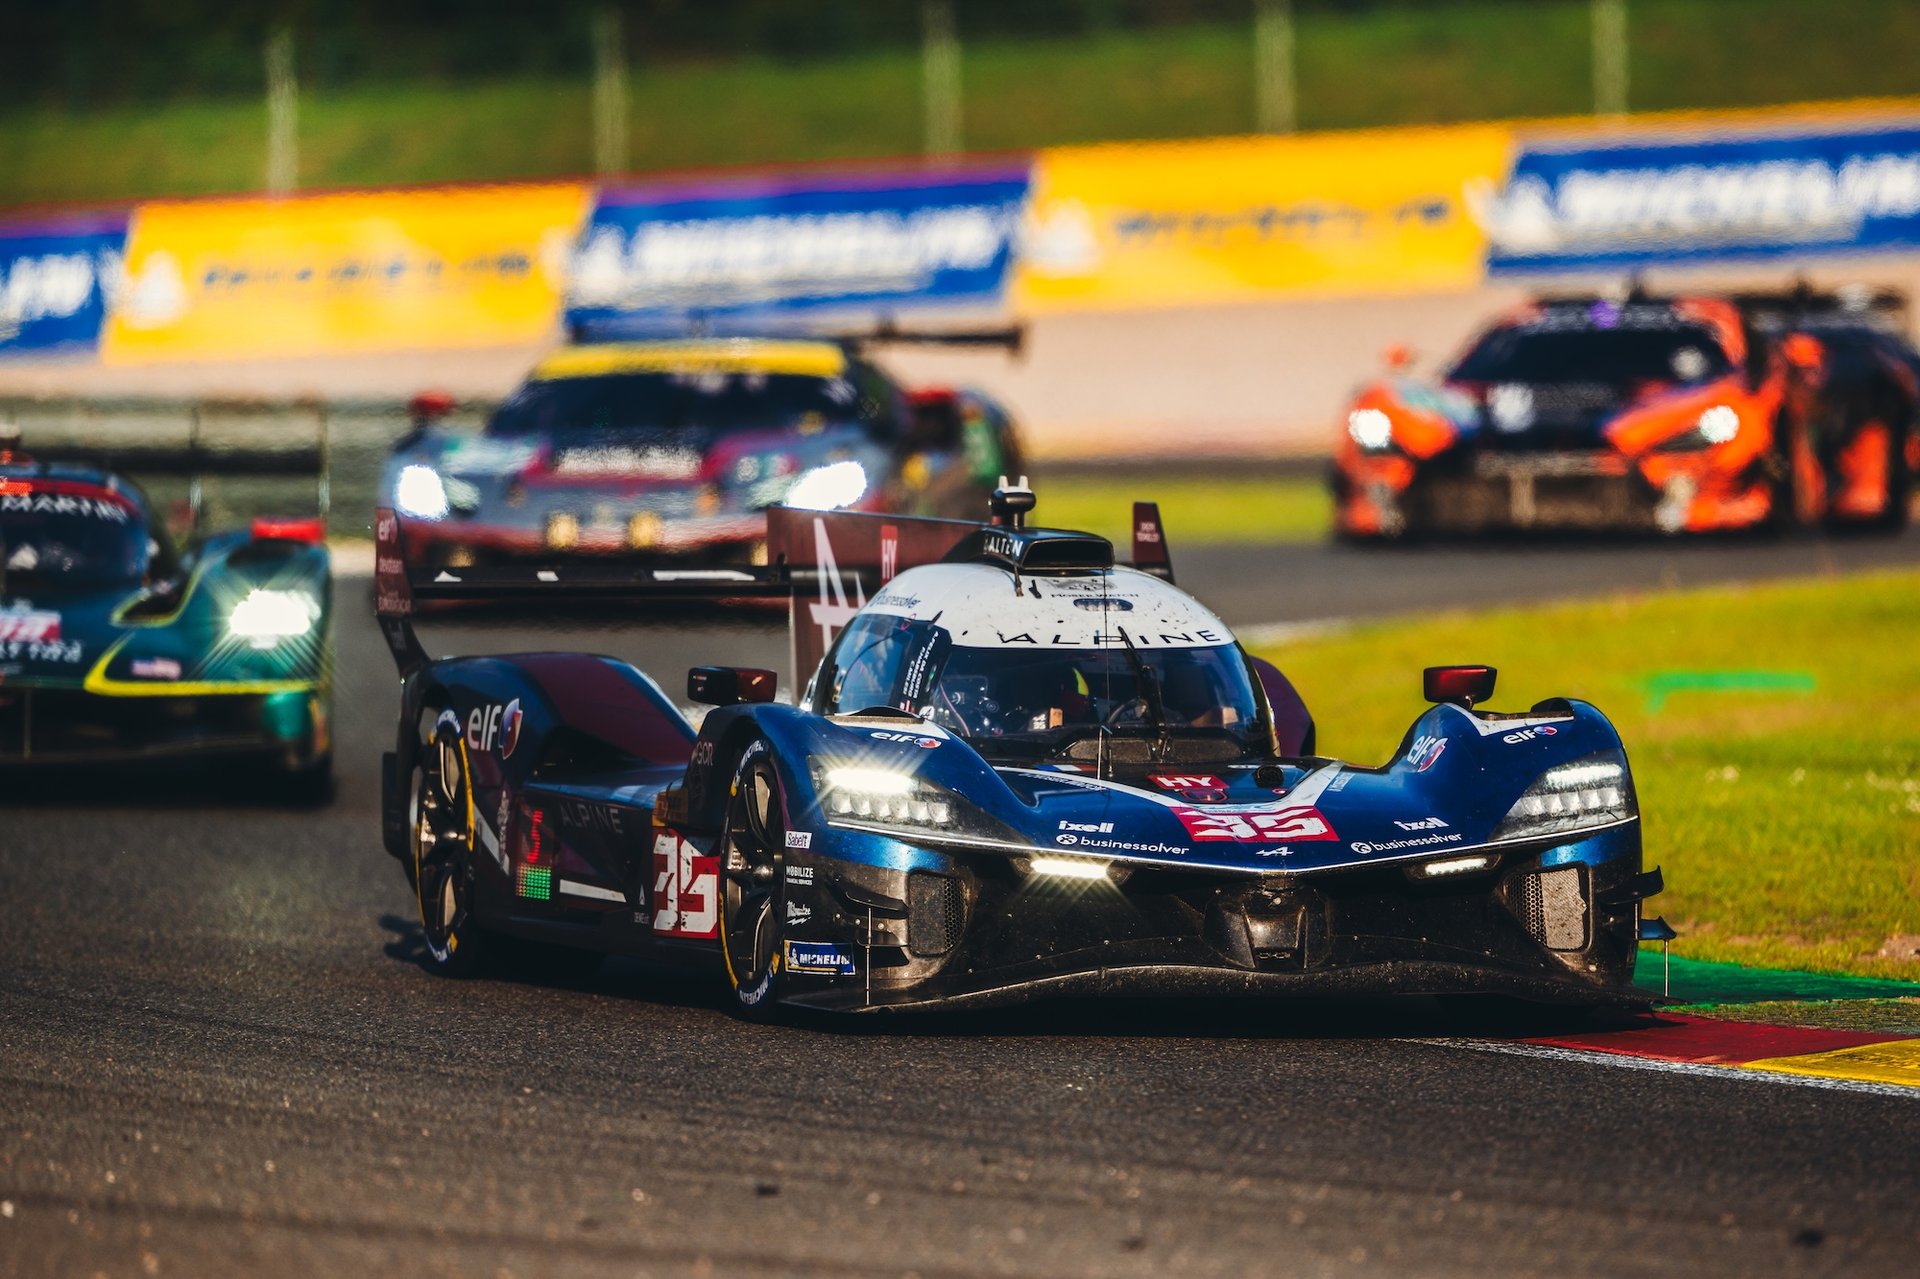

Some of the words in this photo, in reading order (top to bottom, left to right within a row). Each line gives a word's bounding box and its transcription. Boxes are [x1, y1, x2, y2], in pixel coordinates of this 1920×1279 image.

[882, 539, 897, 579] HY
[1000, 630, 1221, 645] ALPINE
[467, 704, 502, 751] elf
[1503, 728, 1538, 745] elf
[870, 731, 916, 743] elf
[1407, 735, 1436, 765] elf
[1157, 776, 1212, 787] HY
[559, 801, 624, 834] ALPINE
[1178, 806, 1329, 839] 35
[1393, 816, 1450, 832] ixell
[1058, 820, 1115, 834] ixell
[787, 832, 808, 847] Sabelt
[1080, 835, 1190, 855] businessolver
[1372, 832, 1463, 852] businessolver
[653, 833, 718, 934] 35
[800, 953, 850, 965] MICHELIN
